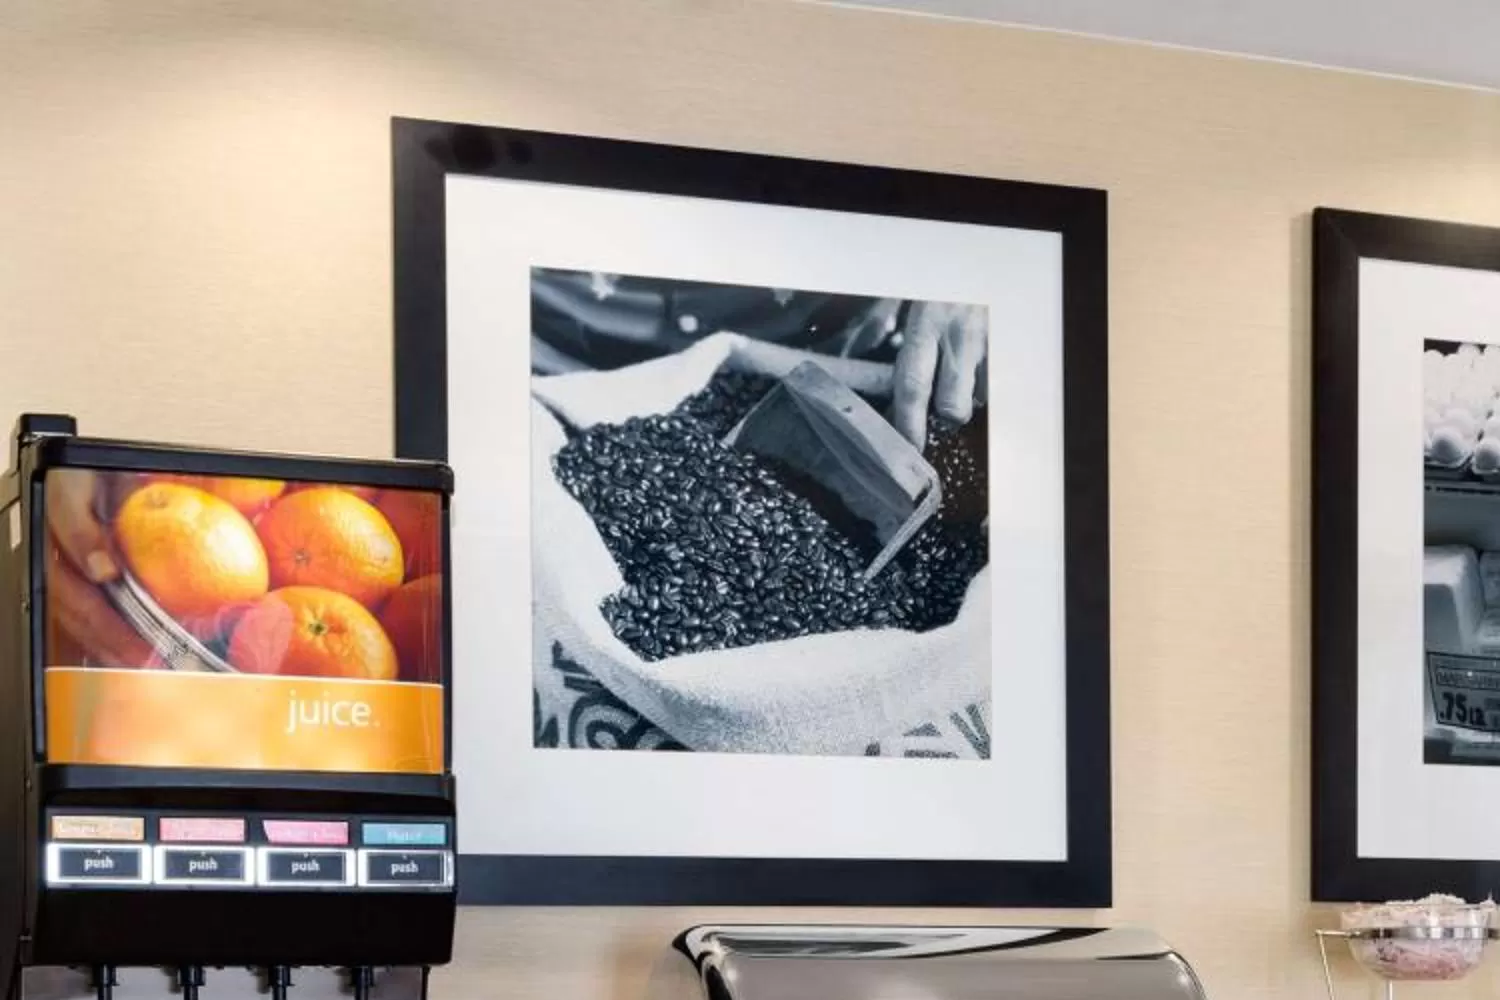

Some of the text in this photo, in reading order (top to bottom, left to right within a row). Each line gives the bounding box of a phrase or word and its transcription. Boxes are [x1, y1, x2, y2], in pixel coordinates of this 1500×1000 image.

[84, 856, 115, 871] push
[189, 858, 218, 872] push
[291, 859, 320, 873] push
[391, 861, 419, 875] push
